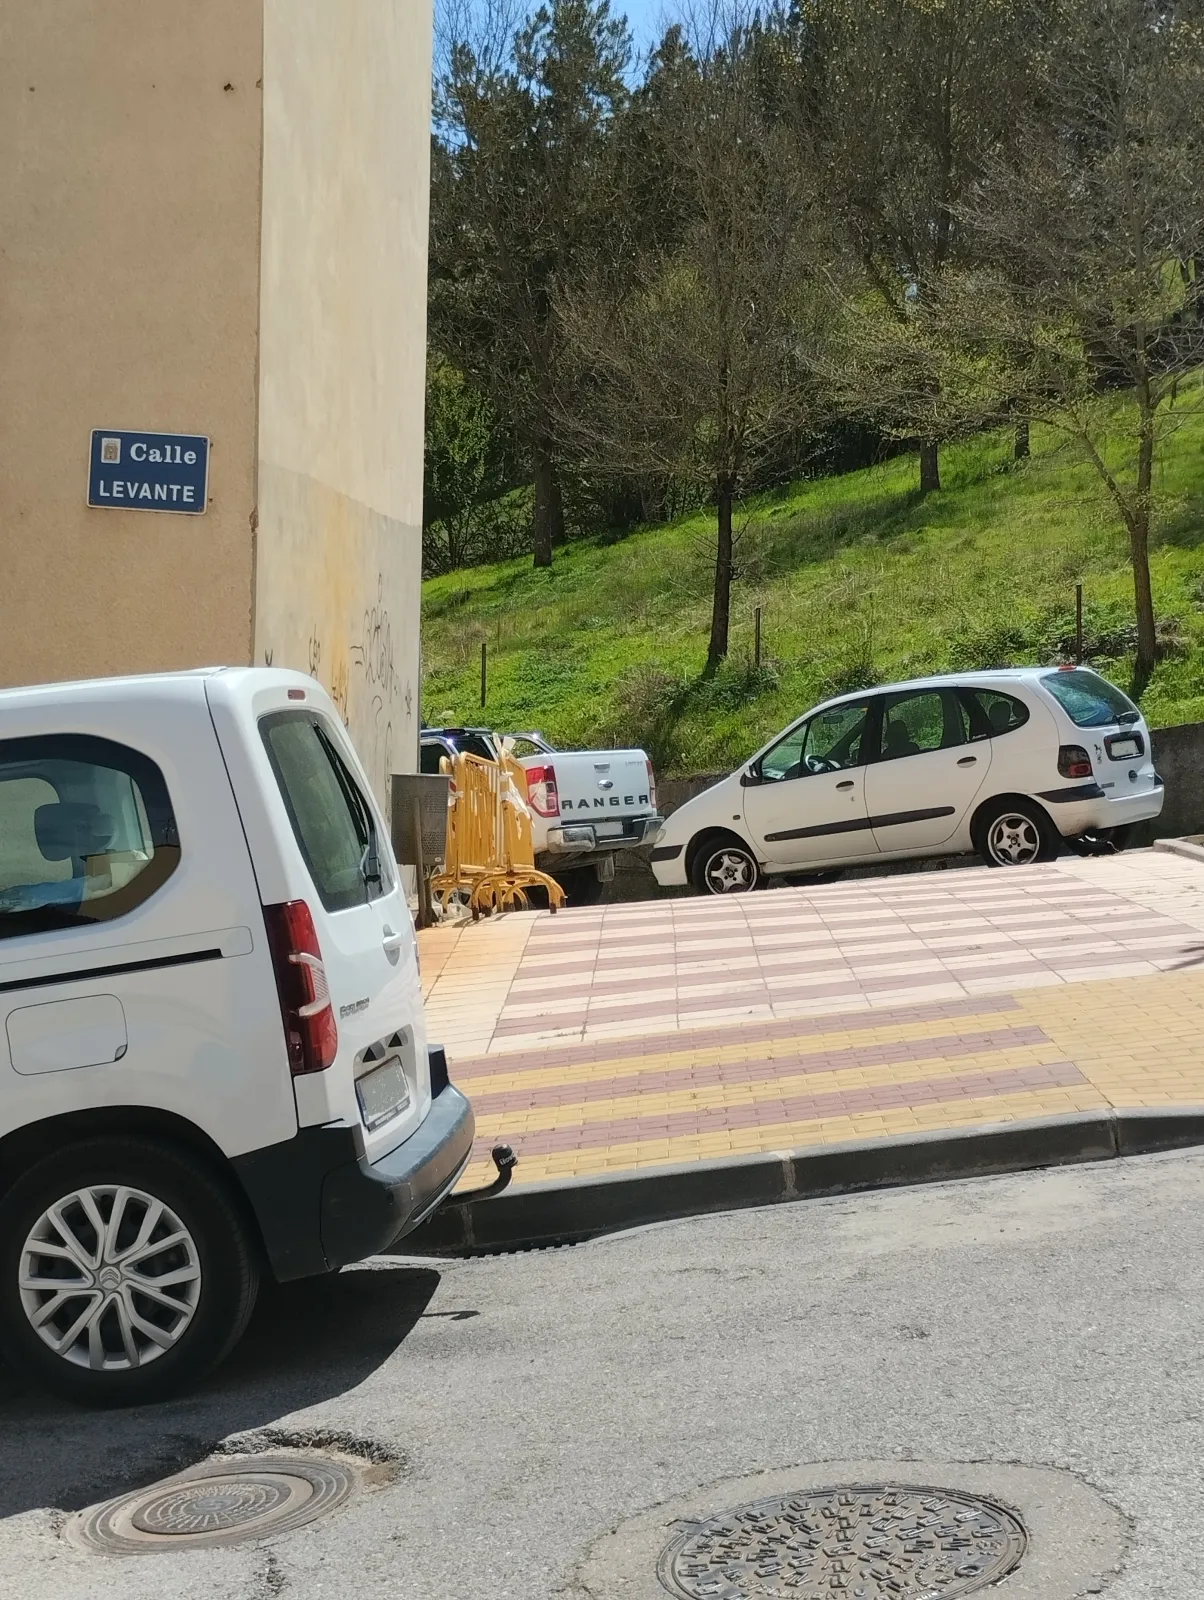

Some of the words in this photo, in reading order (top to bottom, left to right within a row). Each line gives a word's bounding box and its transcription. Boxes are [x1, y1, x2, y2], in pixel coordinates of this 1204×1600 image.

[130, 443, 197, 465] Calle
[99, 480, 195, 503] LEVANTE
[561, 794, 649, 810] RANGER
